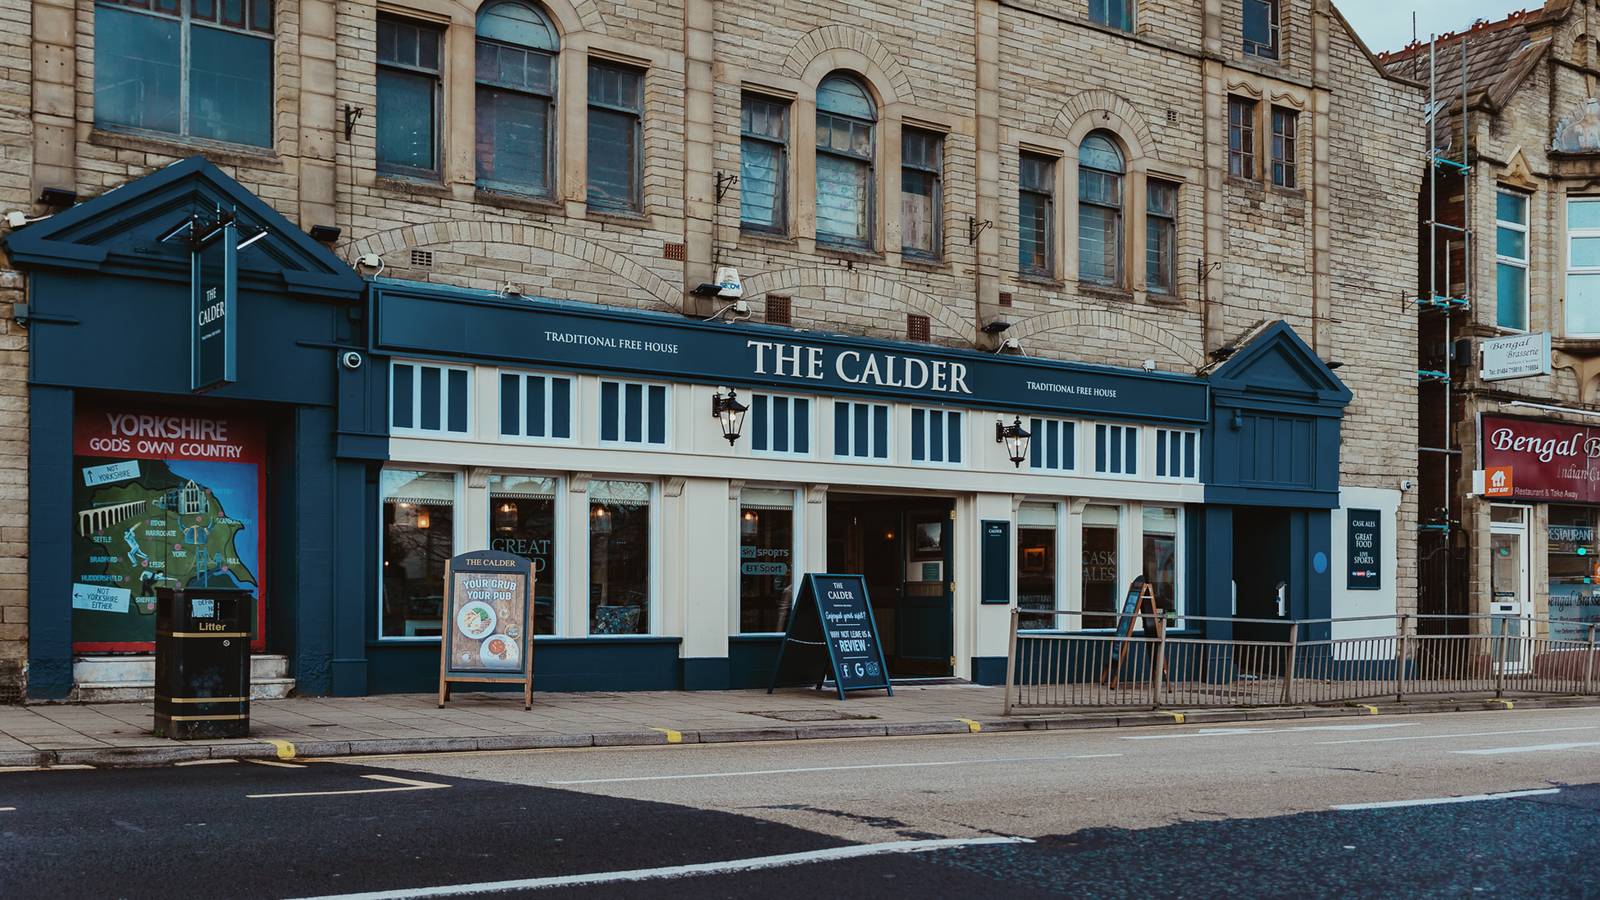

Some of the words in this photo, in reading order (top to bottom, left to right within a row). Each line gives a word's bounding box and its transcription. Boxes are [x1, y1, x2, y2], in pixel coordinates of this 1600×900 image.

[206, 288, 217, 301] THE
[199, 301, 225, 326] CALDER
[544, 331, 616, 348] TRADITIONAL
[619, 339, 643, 350] FREE
[645, 341, 679, 354] HOUSE
[1489, 337, 1532, 350] Bengal
[747, 340, 824, 379] THE
[835, 350, 972, 394] CALDER
[1026, 381, 1075, 394] TRADITIONAL
[1077, 386, 1092, 396] FREE
[1094, 388, 1117, 398] HOUSE
[107, 413, 228, 442] YORKSHIRE
[90, 438, 131, 453] GOD'S
[137, 441, 175, 454] OWN
[180, 443, 243, 458] COUNTRY
[1491, 428, 1583, 463] Bengal
[107, 464, 119, 472] NOT
[98, 470, 132, 482] YORKSHIRE
[1352, 520, 1364, 528] CASK
[1355, 533, 1373, 541] GREAT
[491, 539, 550, 555] GREAT
[1356, 541, 1373, 549] FOOD
[172, 551, 187, 559] YORK
[757, 548, 790, 559] SPORTS
[1082, 551, 1116, 565] CASK
[149, 561, 165, 569] LEEDS
[227, 557, 240, 566] HULL
[466, 559, 481, 567] THE
[483, 559, 517, 568] CALDER
[1354, 556, 1375, 564] SPORTS
[760, 563, 782, 575] Sport
[1083, 567, 1116, 581] ALES
[464, 580, 489, 591] YOUR
[491, 580, 517, 592] GRUB
[97, 588, 109, 596] NOT
[467, 591, 491, 601] YOUR
[493, 591, 513, 601] PUB
[827, 590, 855, 600] CALDER
[87, 594, 120, 604] YORKSHIRE
[92, 601, 113, 610] EITHER
[199, 622, 227, 632] Litter
[840, 631, 850, 639] NOT
[839, 640, 867, 652] REVIEW
